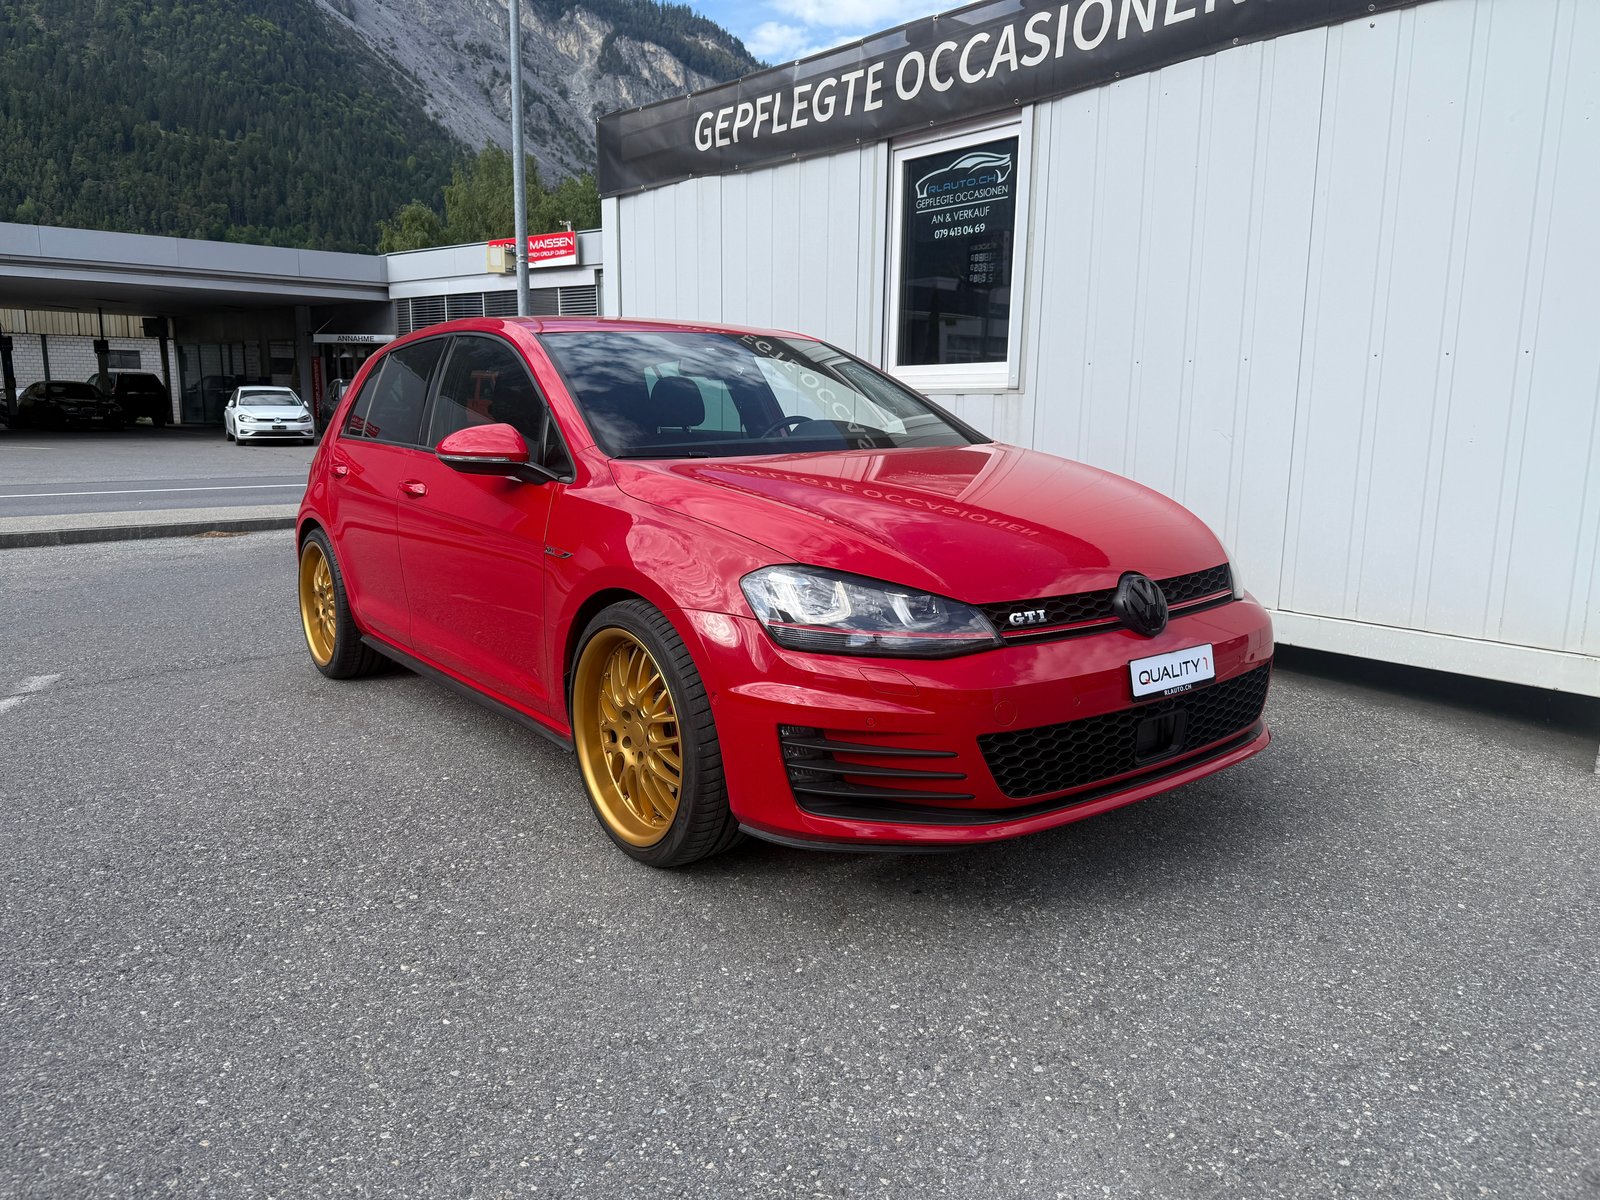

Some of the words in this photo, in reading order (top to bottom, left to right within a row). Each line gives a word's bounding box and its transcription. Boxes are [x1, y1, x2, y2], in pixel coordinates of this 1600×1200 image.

[694, 61, 884, 152] GEPFLEGTE
[895, 0, 1246, 101] OCCASION
[928, 175, 996, 193] RLAUTO.CH
[916, 194, 953, 209] GEPFLEGTE
[955, 185, 1008, 202] OCCASIONEN
[931, 214, 944, 225] AN
[945, 213, 952, 223] &
[953, 206, 990, 220] VERKAUF
[934, 228, 949, 239] 079
[949, 226, 962, 237] 413
[962, 224, 974, 235] 04
[974, 223, 985, 232] 69
[529, 236, 574, 250] MAISSEN
[1008, 609, 1048, 627] GTI
[1138, 658, 1200, 686] QUALITY
[1202, 656, 1209, 671] 1
[1163, 683, 1193, 696] RLAUTO.CH
